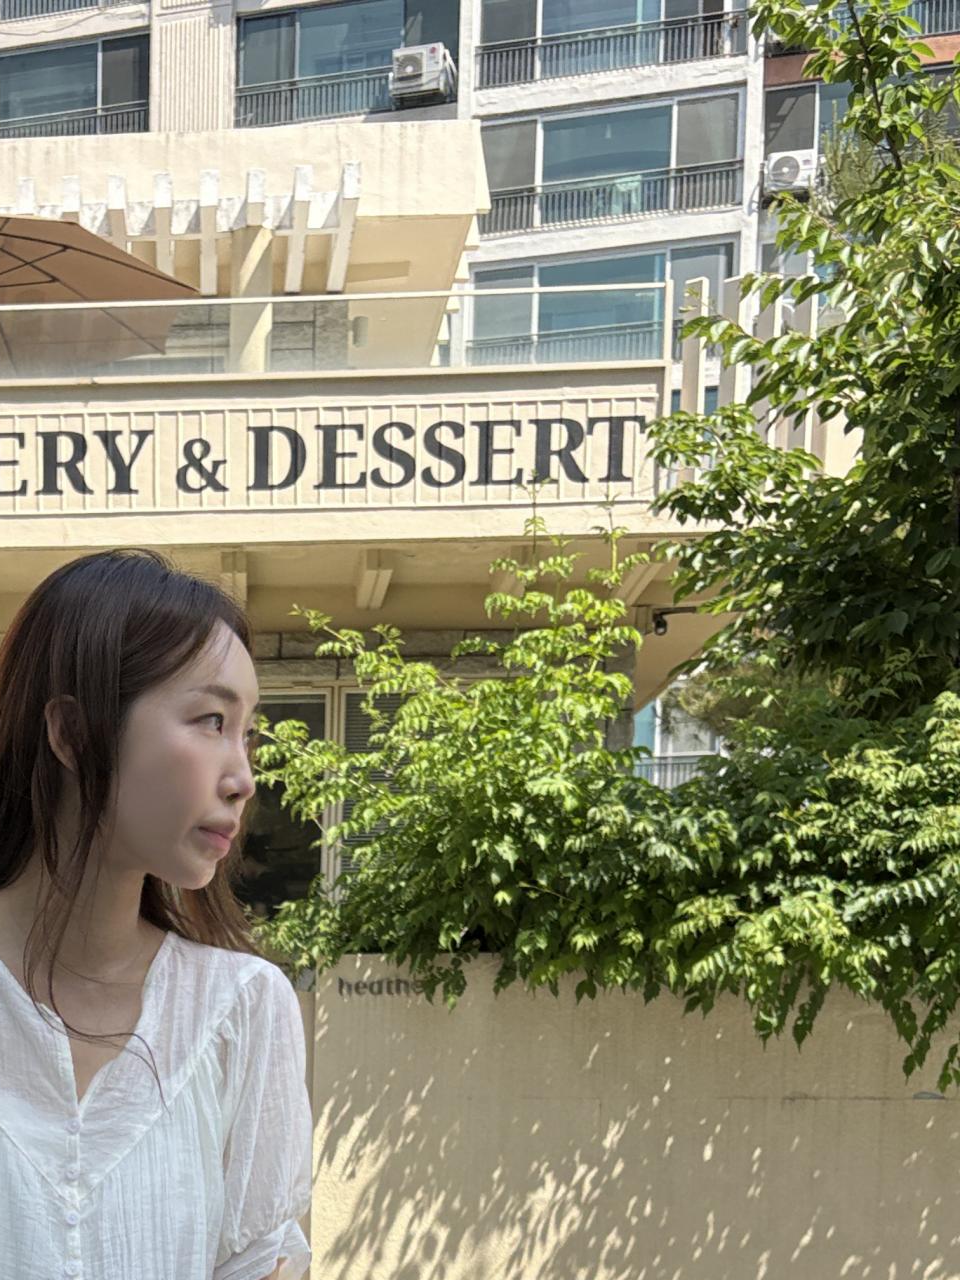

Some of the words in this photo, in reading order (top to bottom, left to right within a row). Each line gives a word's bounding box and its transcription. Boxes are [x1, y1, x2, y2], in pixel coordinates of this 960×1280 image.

[175, 437, 230, 494] &
[246, 415, 646, 492] DESSERT
[338, 976, 432, 998] heathe
